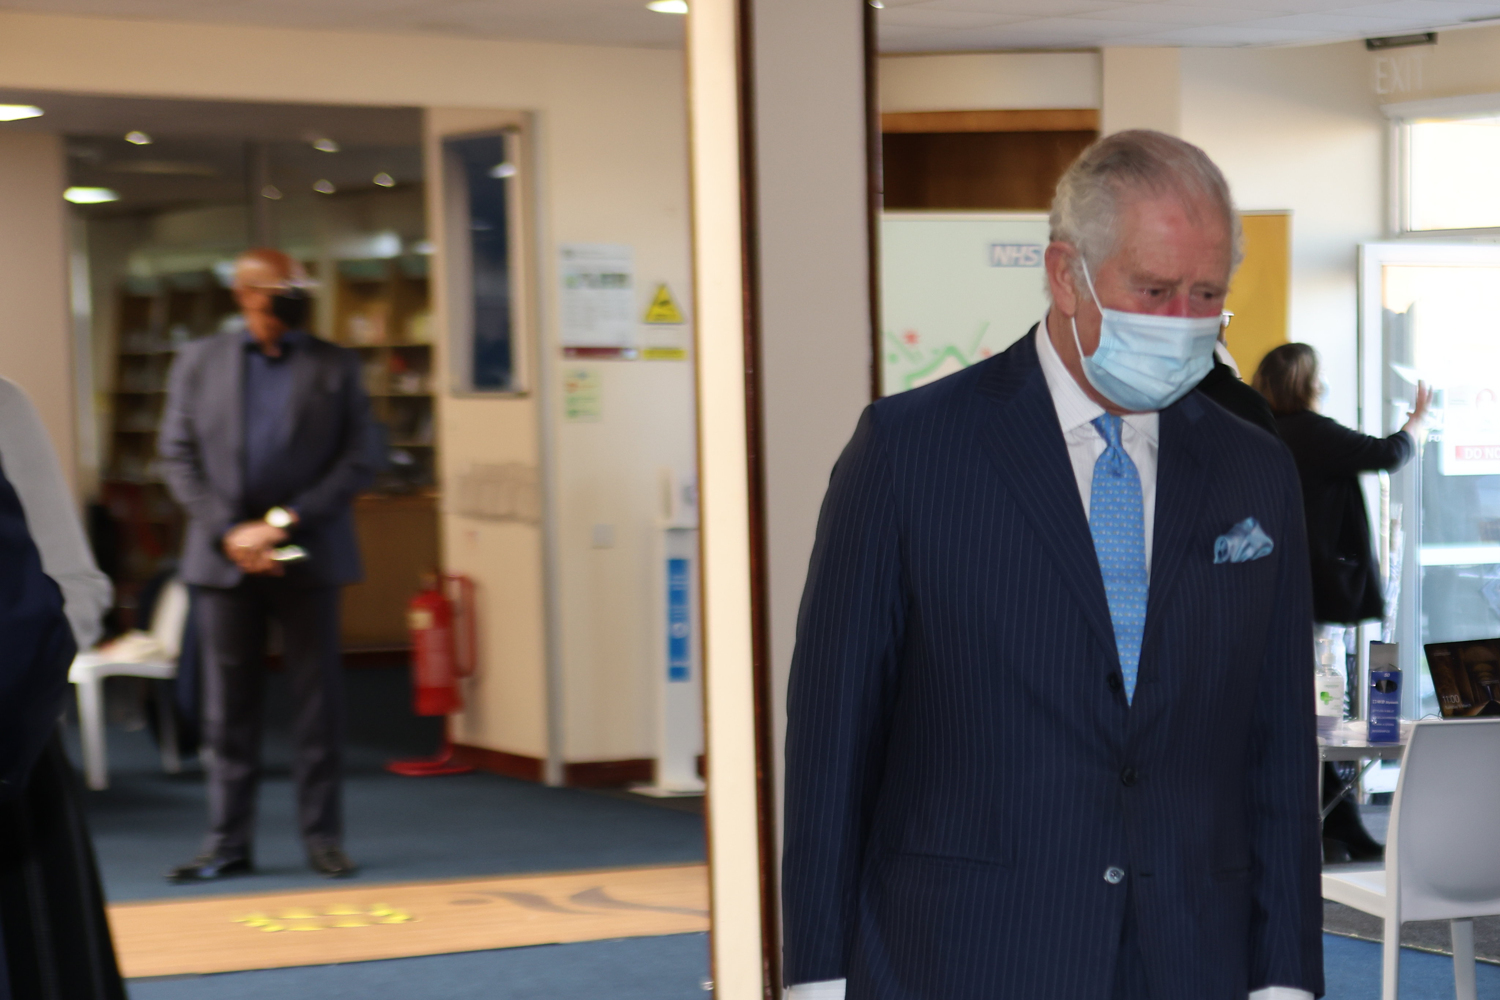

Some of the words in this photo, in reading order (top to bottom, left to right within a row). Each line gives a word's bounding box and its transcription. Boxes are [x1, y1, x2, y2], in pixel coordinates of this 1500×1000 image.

[1376, 53, 1426, 94] EXIT
[993, 246, 1040, 265] NHS
[1465, 448, 1483, 459] DO
[1442, 694, 1460, 703] 11:00
